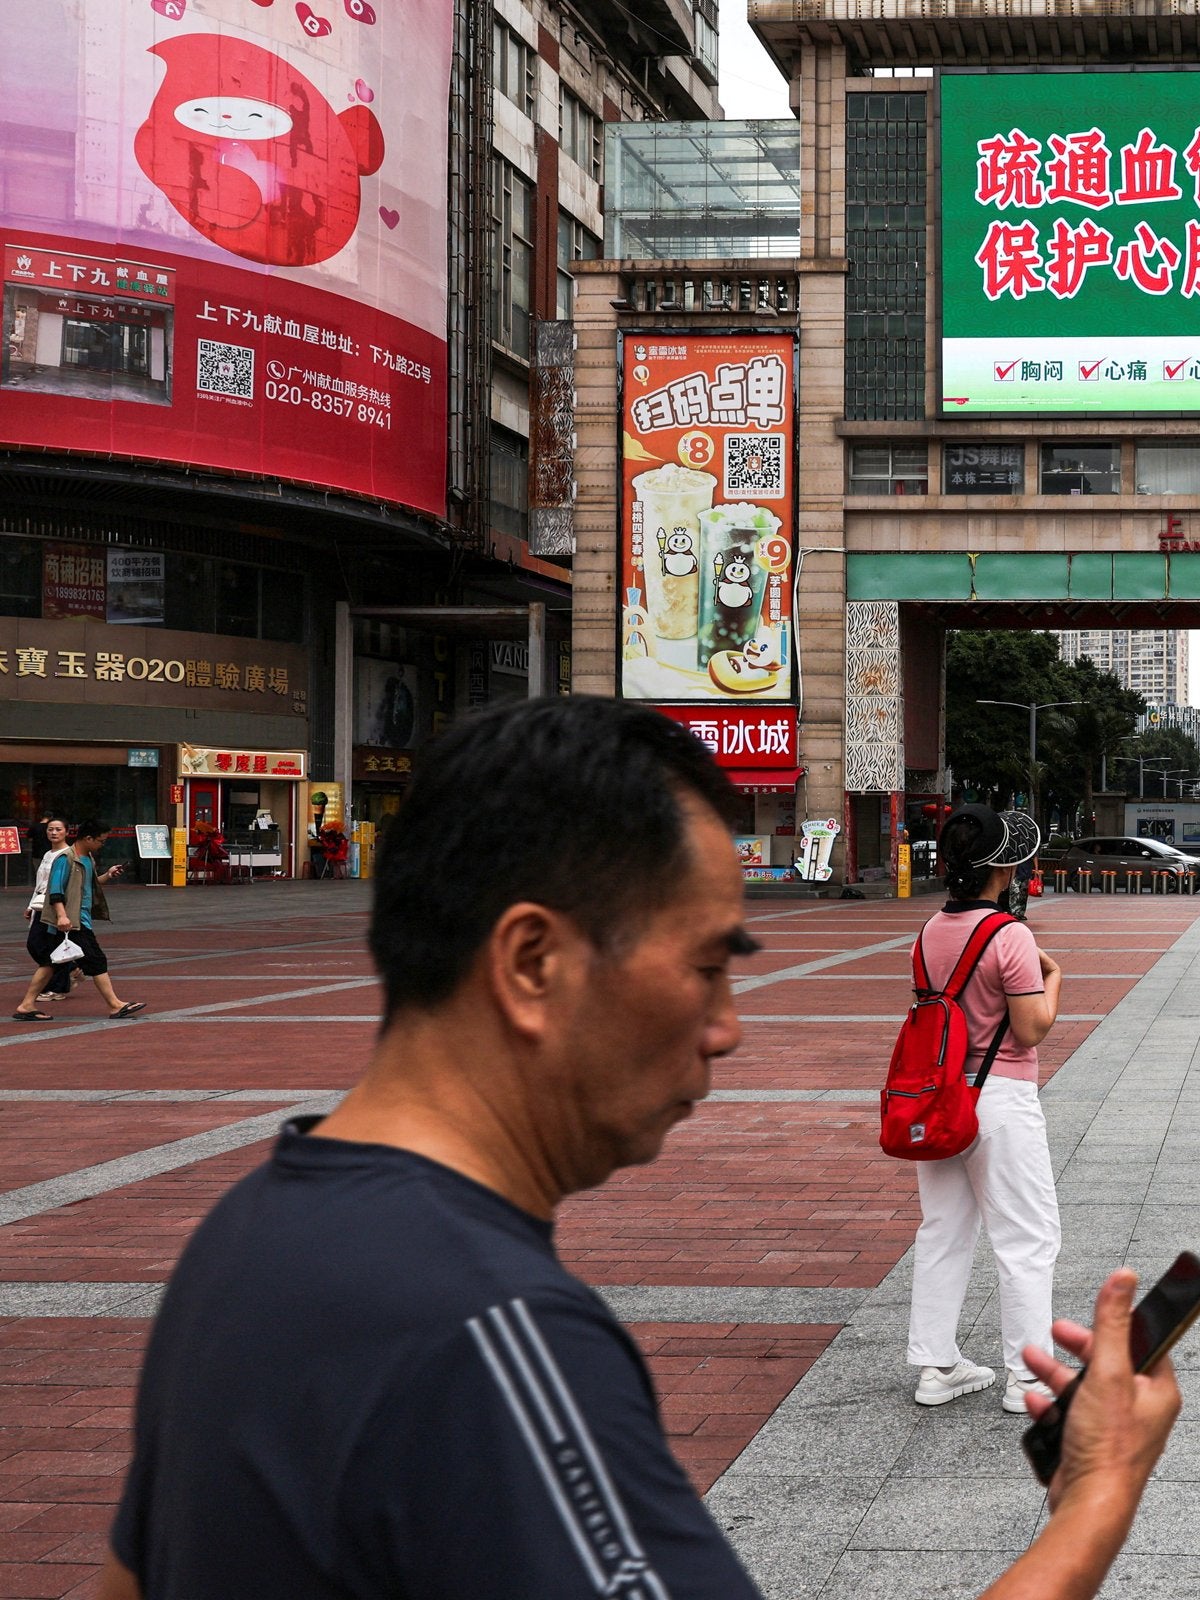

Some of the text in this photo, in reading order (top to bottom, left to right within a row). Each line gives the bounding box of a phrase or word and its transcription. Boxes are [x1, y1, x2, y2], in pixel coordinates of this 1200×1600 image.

[42, 261, 110, 286] 上下九
[196, 300, 432, 384] 上下九献血屋地址： 下九路25号
[287, 366, 391, 408] 广州献血服务热线
[1020, 361, 1063, 381] 胸闷
[1104, 360, 1147, 381] 心痛
[265, 380, 391, 430] 020-8357 8941
[632, 356, 785, 434] 扫码点单
[688, 436, 710, 463] 8
[950, 447, 1020, 466] JS舞蹈
[951, 472, 1020, 485] 本栋二三楼
[632, 501, 643, 555] 蜜桃四季春
[45, 553, 105, 586] 商铺招租
[767, 539, 789, 568] 9
[689, 719, 790, 755] 雪冰城
